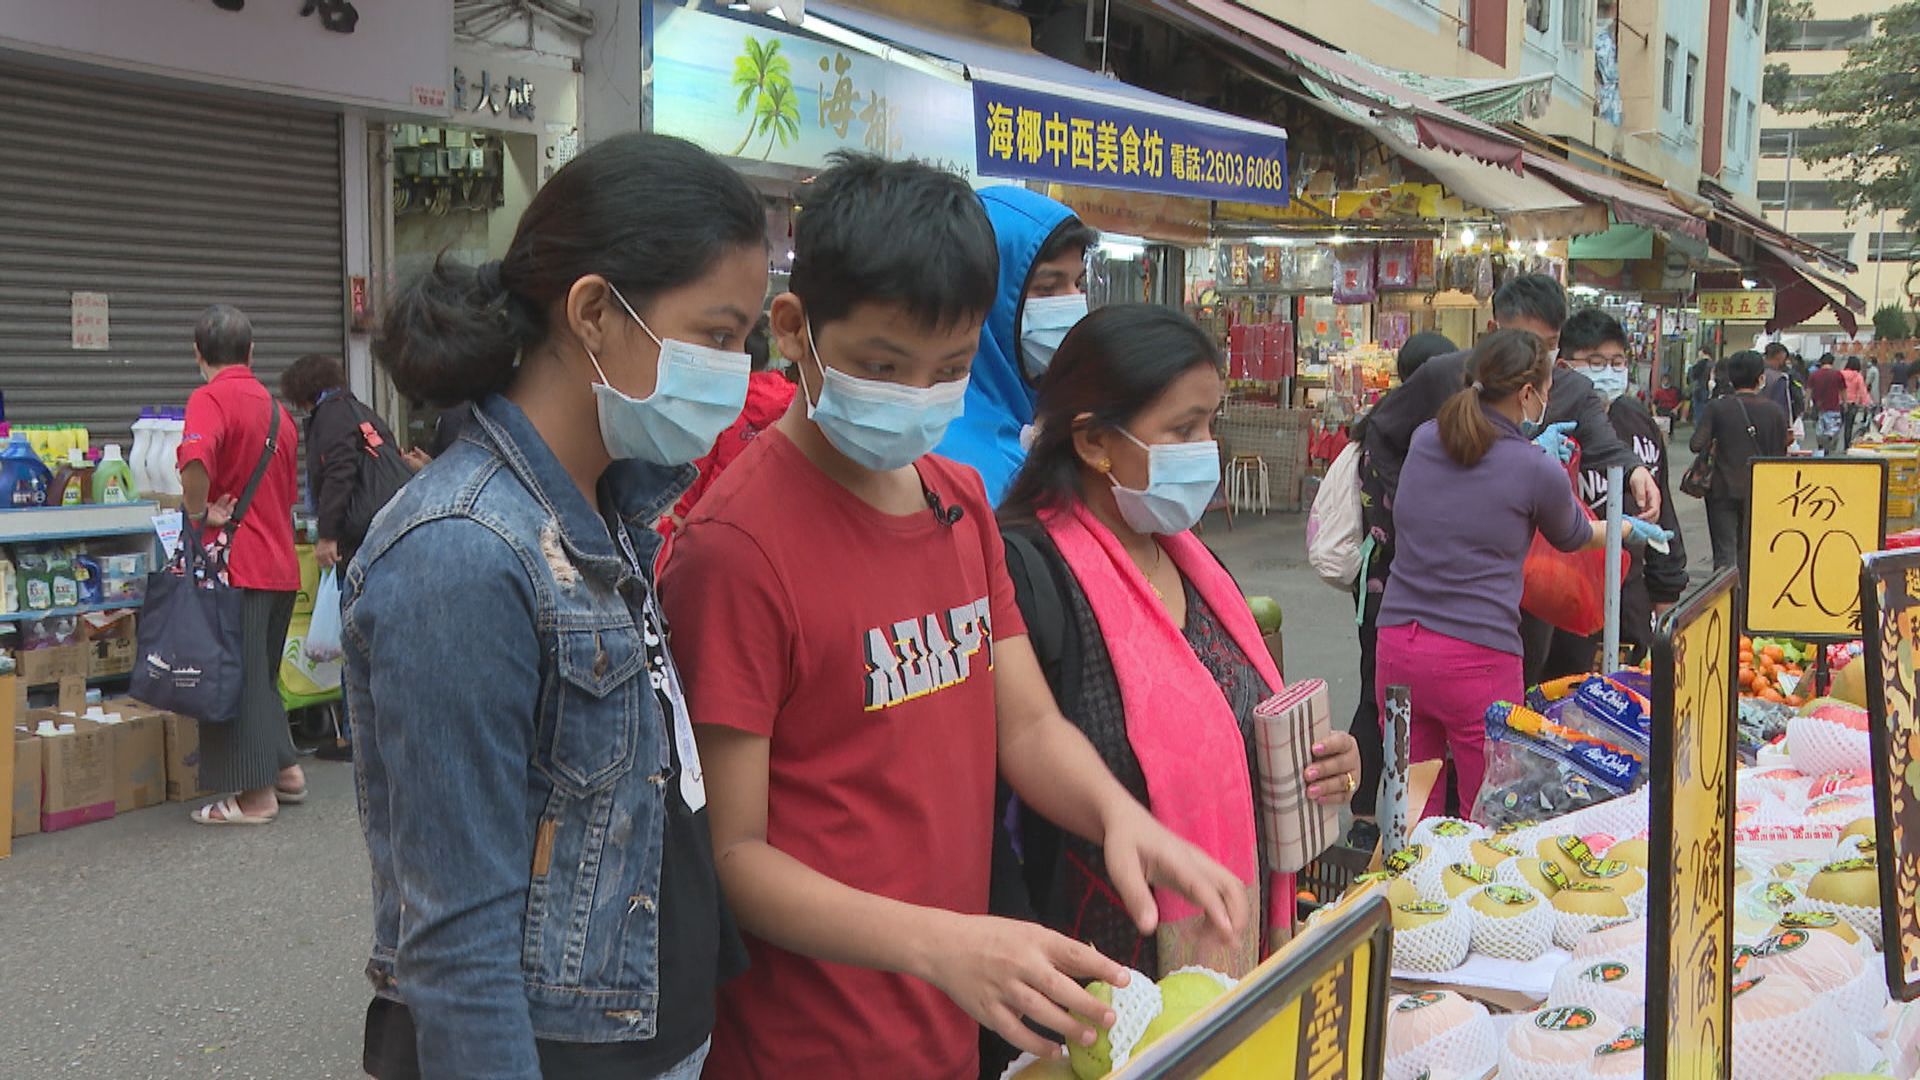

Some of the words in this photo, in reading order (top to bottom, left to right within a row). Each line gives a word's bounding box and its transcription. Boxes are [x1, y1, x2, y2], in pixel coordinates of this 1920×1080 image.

[986, 101, 1165, 178] 海椰中西美食坊
[1246, 155, 1283, 190] 6088
